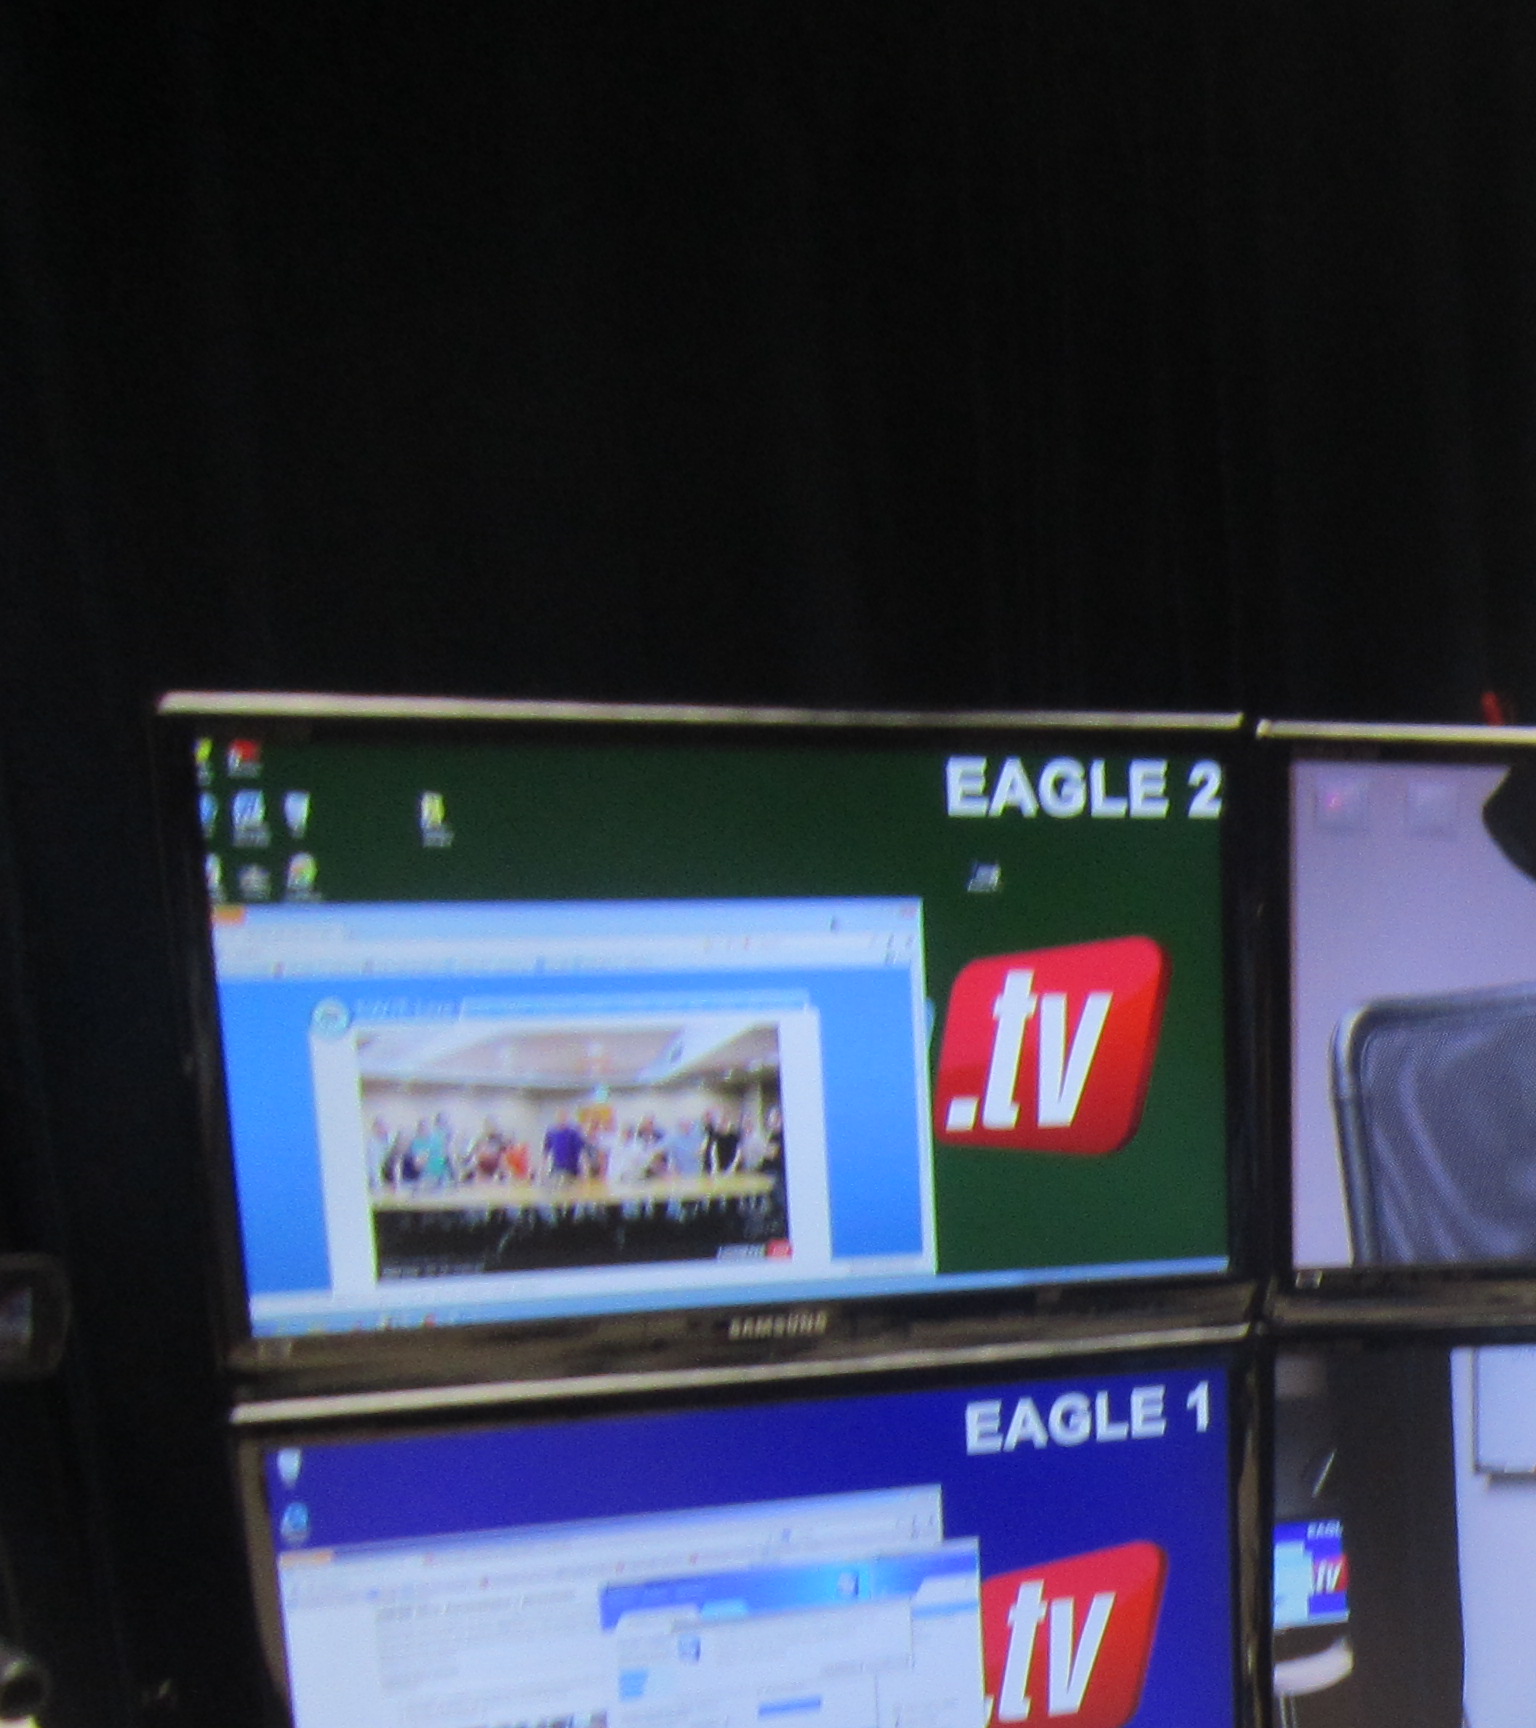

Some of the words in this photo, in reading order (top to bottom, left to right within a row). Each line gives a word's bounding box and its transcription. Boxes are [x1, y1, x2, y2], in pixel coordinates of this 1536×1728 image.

[946, 755, 1170, 818] EAGLE
[1187, 759, 1222, 819] 2
[946, 968, 1113, 1132] .tv
[729, 1308, 828, 1339] SAMSUNG
[965, 1385, 1166, 1456] EAGLE
[1186, 1380, 1209, 1433] 1
